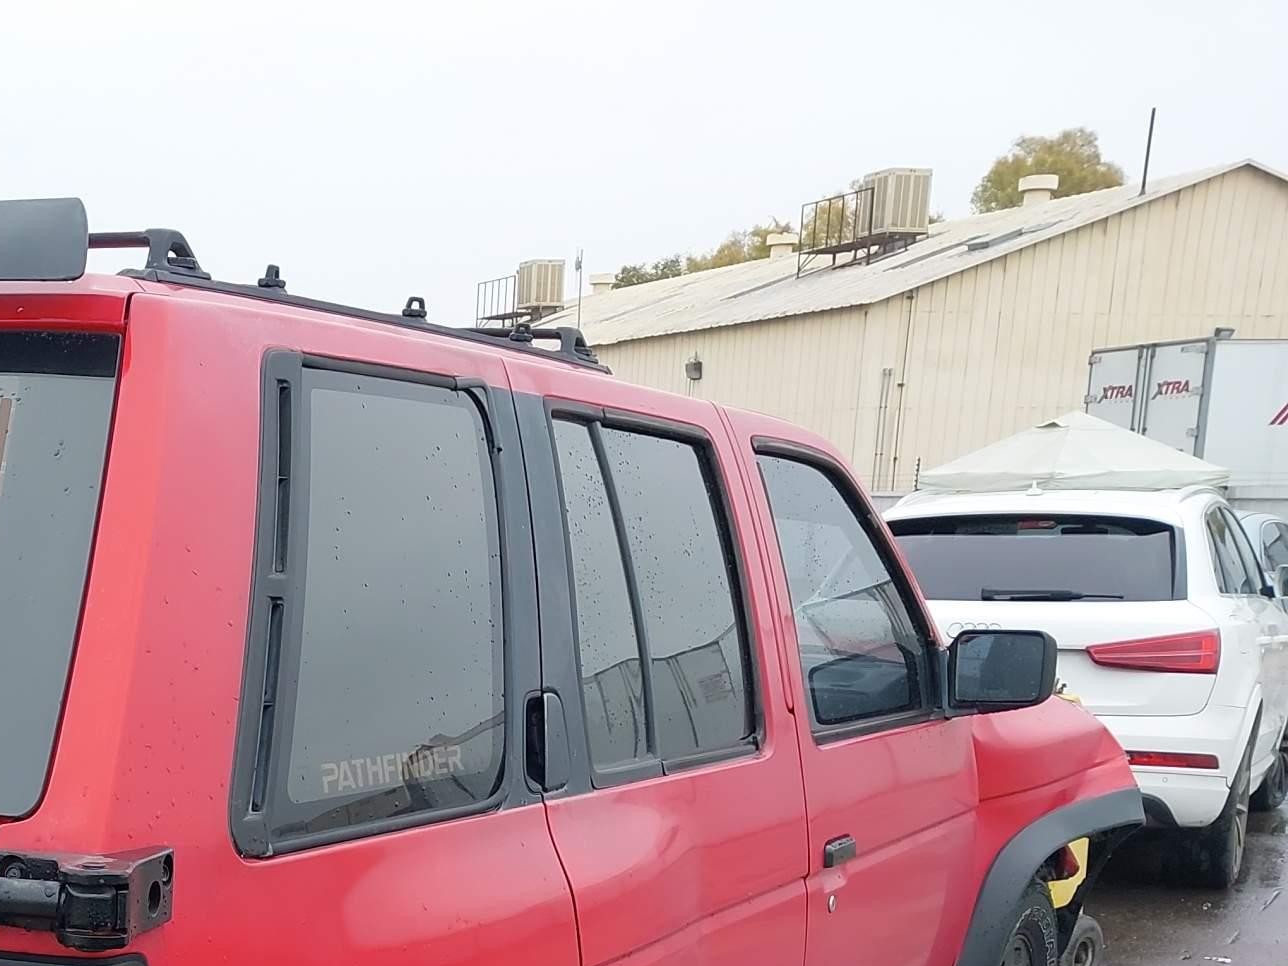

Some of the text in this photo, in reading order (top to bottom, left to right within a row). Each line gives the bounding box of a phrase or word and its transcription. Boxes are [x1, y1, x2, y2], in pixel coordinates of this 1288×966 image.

[1097, 384, 1133, 404] XTRA
[1150, 379, 1190, 400] XTRA
[320, 744, 464, 794] PATHFINDER
